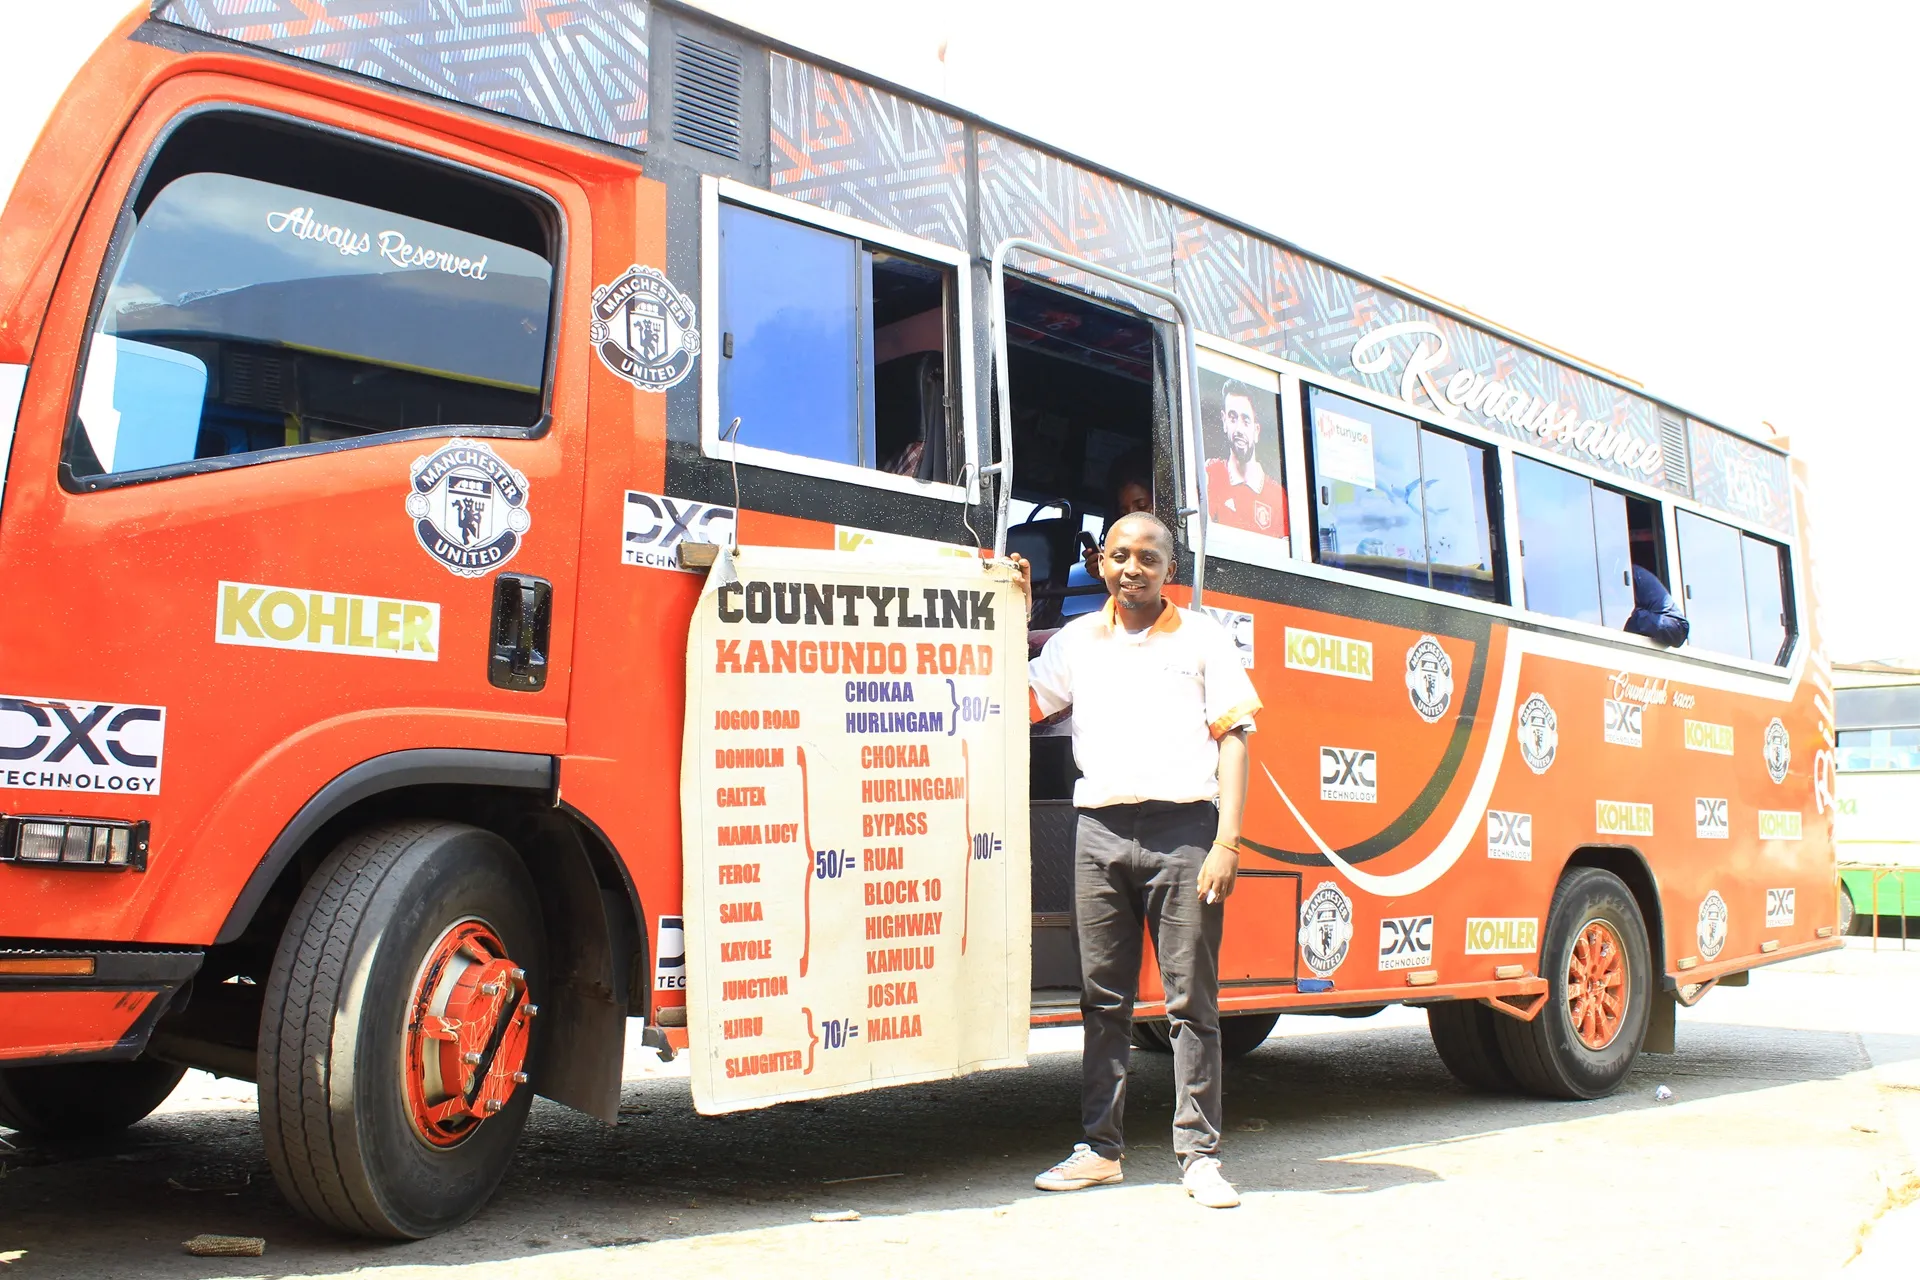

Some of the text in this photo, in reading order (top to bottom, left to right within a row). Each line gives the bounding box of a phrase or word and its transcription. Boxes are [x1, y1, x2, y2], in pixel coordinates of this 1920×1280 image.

[266, 207, 488, 281] Always Reserved
[602, 278, 686, 323] MANCHESTER
[621, 358, 676, 381] UNITED
[421, 450, 517, 500] MANCHESTER
[434, 538, 501, 566] UNITED
[221, 584, 436, 654] KOHLER
[717, 580, 996, 630] COUNTYLINK
[715, 639, 993, 676] KANGUNDO ROAD
[1287, 631, 1371, 676] KOHLER
[1411, 642, 1448, 673] MANCHESTER
[845, 681, 914, 702] CHOKAA
[714, 710, 800, 730] JOGOO ROAD
[845, 711, 944, 734] HURLINGAM
[962, 696, 1001, 722] 80/=
[1416, 702, 1444, 717] UNITED
[1605, 701, 1641, 734] DXC
[0, 697, 161, 768] DXC
[1686, 721, 1733, 751] KOHLER
[715, 748, 784, 769] DONHOLM
[861, 745, 930, 769] CHOKAA
[1322, 748, 1375, 788] DXC
[716, 786, 766, 808] CALTEX
[861, 777, 965, 804] HURLINGGAM
[1322, 789, 1375, 801] TECHNOLOGY
[862, 812, 928, 838] BYPASS
[1599, 803, 1652, 832] KOHLER
[1697, 799, 1728, 827] DXC
[1760, 813, 1800, 836] KOHLER
[718, 823, 799, 847] MAMA LUCY
[1489, 811, 1531, 847] DXC
[863, 847, 904, 872] RUAI
[973, 832, 1002, 860] 100/=
[1489, 848, 1530, 861] TECHNOLOGY
[718, 863, 761, 885] FEROZ
[816, 849, 856, 880] 50/=
[864, 878, 942, 906] BLOCK 10
[1305, 890, 1349, 922] MANCHESTER
[1767, 889, 1794, 916] DXC
[719, 901, 763, 924] SAIKA
[865, 912, 943, 940] HIGHWAY
[1381, 917, 1432, 956] DXC
[1467, 920, 1537, 951] KOHLER
[720, 939, 772, 963] KAYOLE
[866, 946, 935, 975] KAMULU
[1310, 953, 1342, 971] UNITED
[1380, 956, 1431, 969] TECHNOLOGY
[722, 976, 788, 1002] JUNCTION
[867, 981, 918, 1009] JOSKA
[723, 1016, 763, 1040] NJIRU
[821, 1018, 859, 1050] 70/=
[867, 1015, 922, 1043] MALAA
[725, 1050, 803, 1079] SLAUGHTER
